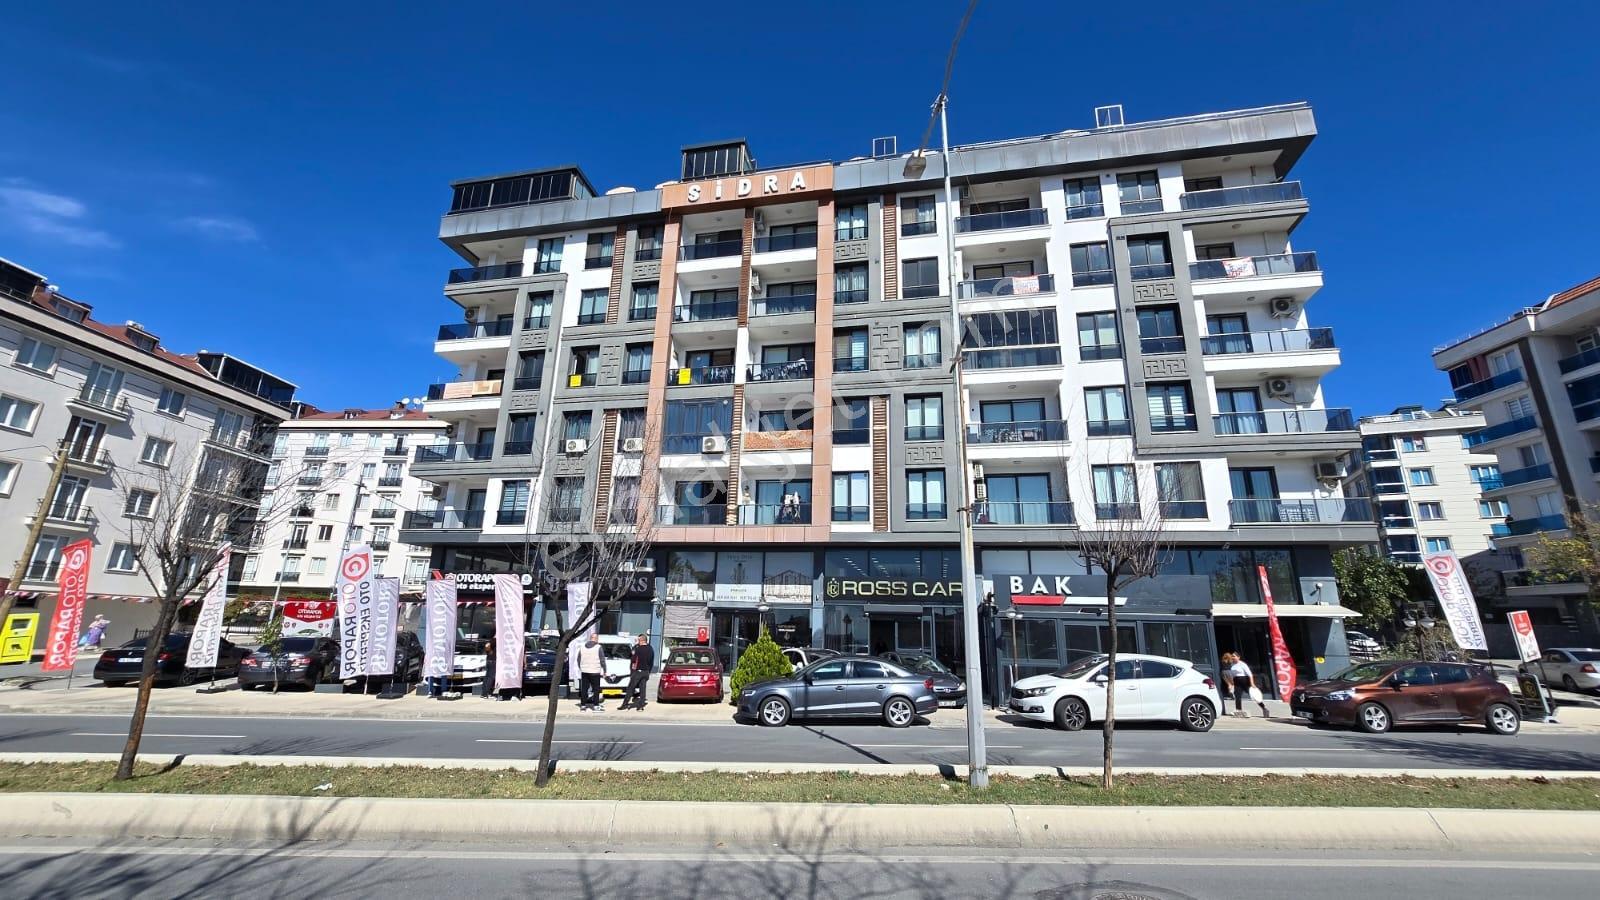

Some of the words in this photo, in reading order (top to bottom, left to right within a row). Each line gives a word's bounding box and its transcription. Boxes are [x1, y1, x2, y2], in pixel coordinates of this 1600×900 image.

[457, 573, 494, 582] OTORAP
[1009, 575, 1072, 595] BAK
[842, 581, 908, 596] ROSS
[912, 582, 963, 597] CAR
